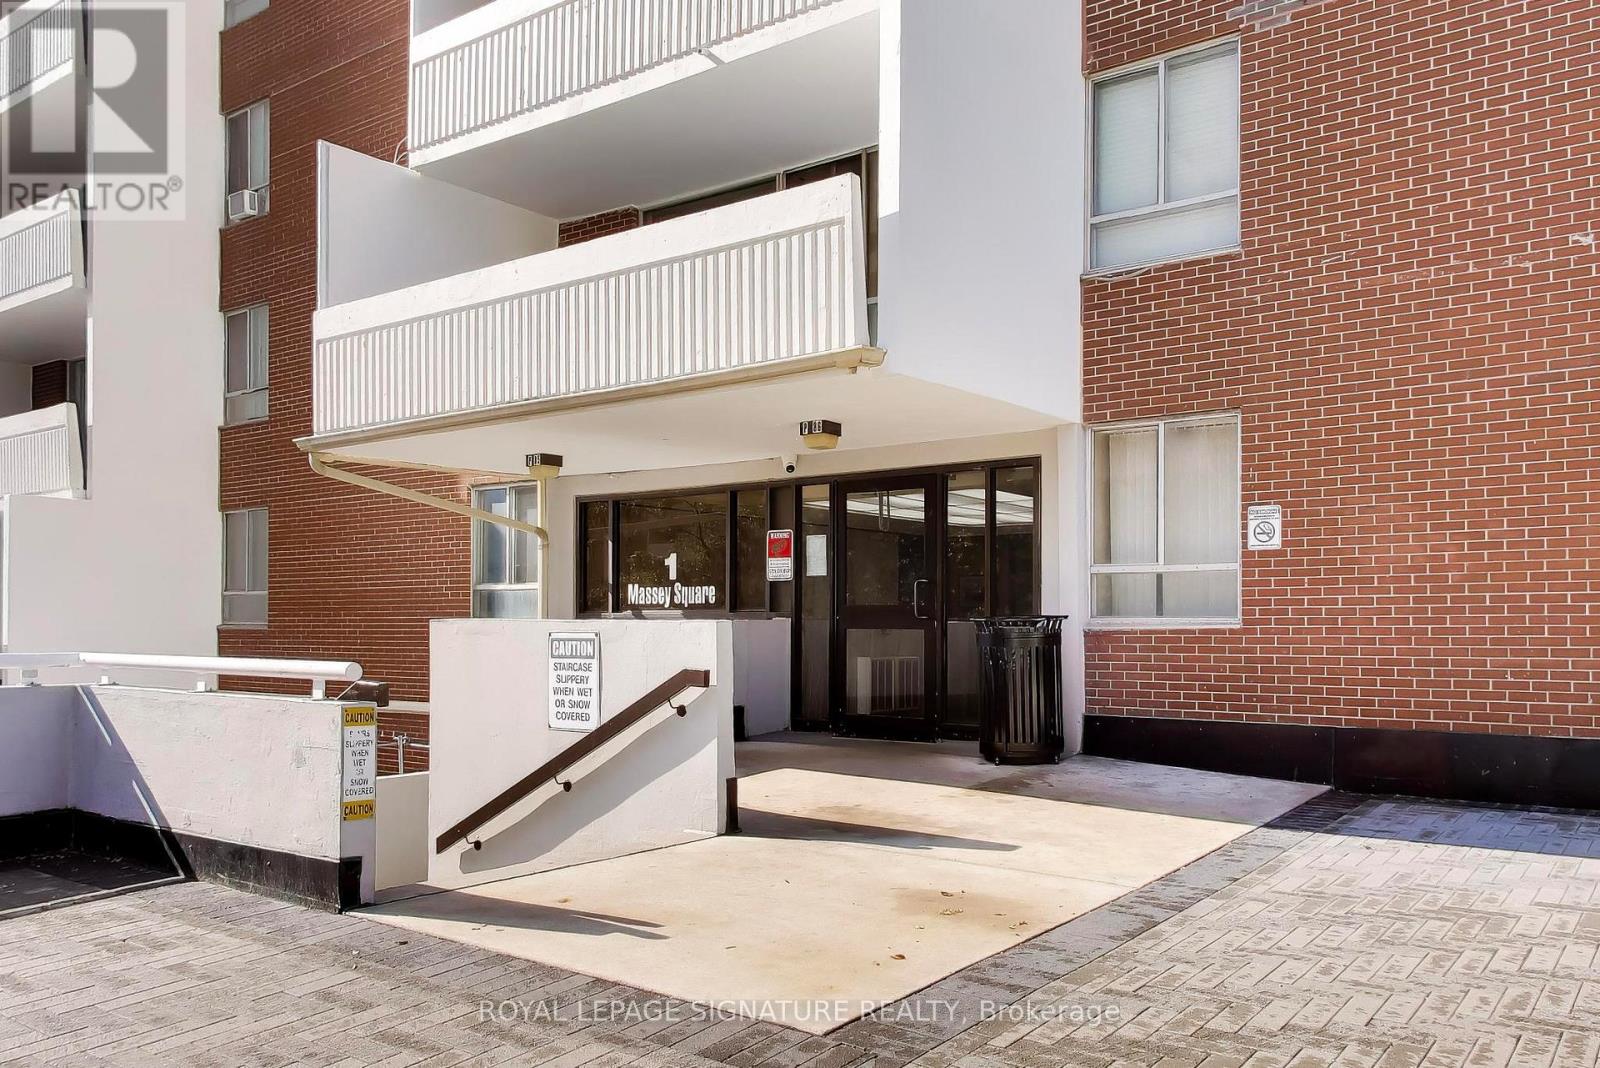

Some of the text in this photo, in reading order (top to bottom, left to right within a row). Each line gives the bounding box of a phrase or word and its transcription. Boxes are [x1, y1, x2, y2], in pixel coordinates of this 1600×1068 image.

[664, 552, 677, 580] 1
[627, 582, 716, 608] Massey Square
[552, 640, 594, 657] CAUTION
[553, 662, 593, 672] STAIRCASE
[555, 674, 590, 684] SLIPPERY
[552, 686, 593, 697] WHEN WET
[554, 699, 591, 710] OR SNOW
[345, 711, 375, 723] CAUTION
[555, 711, 591, 722] COVERED
[344, 786, 374, 796] COVERED
[343, 803, 373, 817] CAUTION
